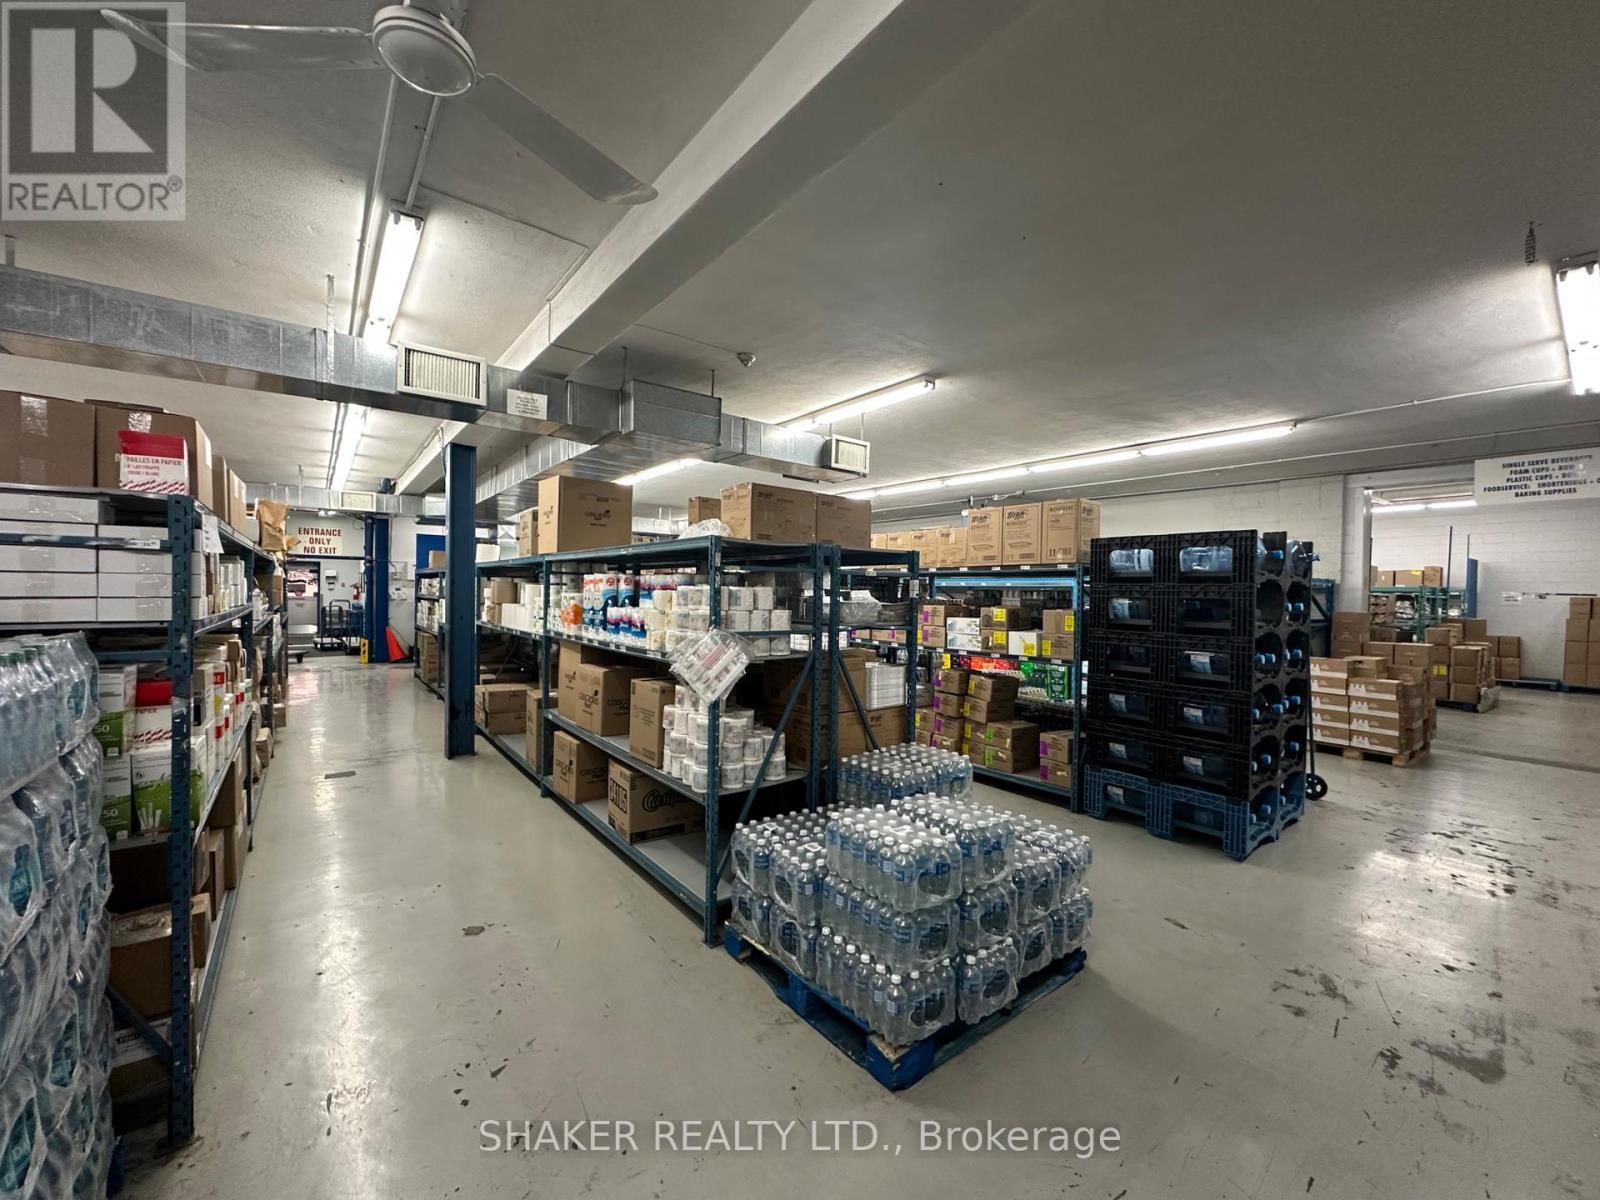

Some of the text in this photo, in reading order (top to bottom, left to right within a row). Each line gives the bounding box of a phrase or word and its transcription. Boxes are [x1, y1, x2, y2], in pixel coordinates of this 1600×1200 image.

[1502, 461, 1525, 469] SINGLE
[1527, 459, 1548, 467] SERVE
[1509, 468, 1530, 476] FOAM
[1531, 466, 1550, 474] CUPS
[1506, 475, 1533, 483] PLASTIC
[1483, 483, 1531, 493] FOODSERVICE:
[1515, 487, 1577, 498] BAKING SUPPLIES
[298, 527, 343, 537] ENTRANCE
[309, 537, 331, 546] ONLY
[304, 546, 337, 555] NO EXIT
